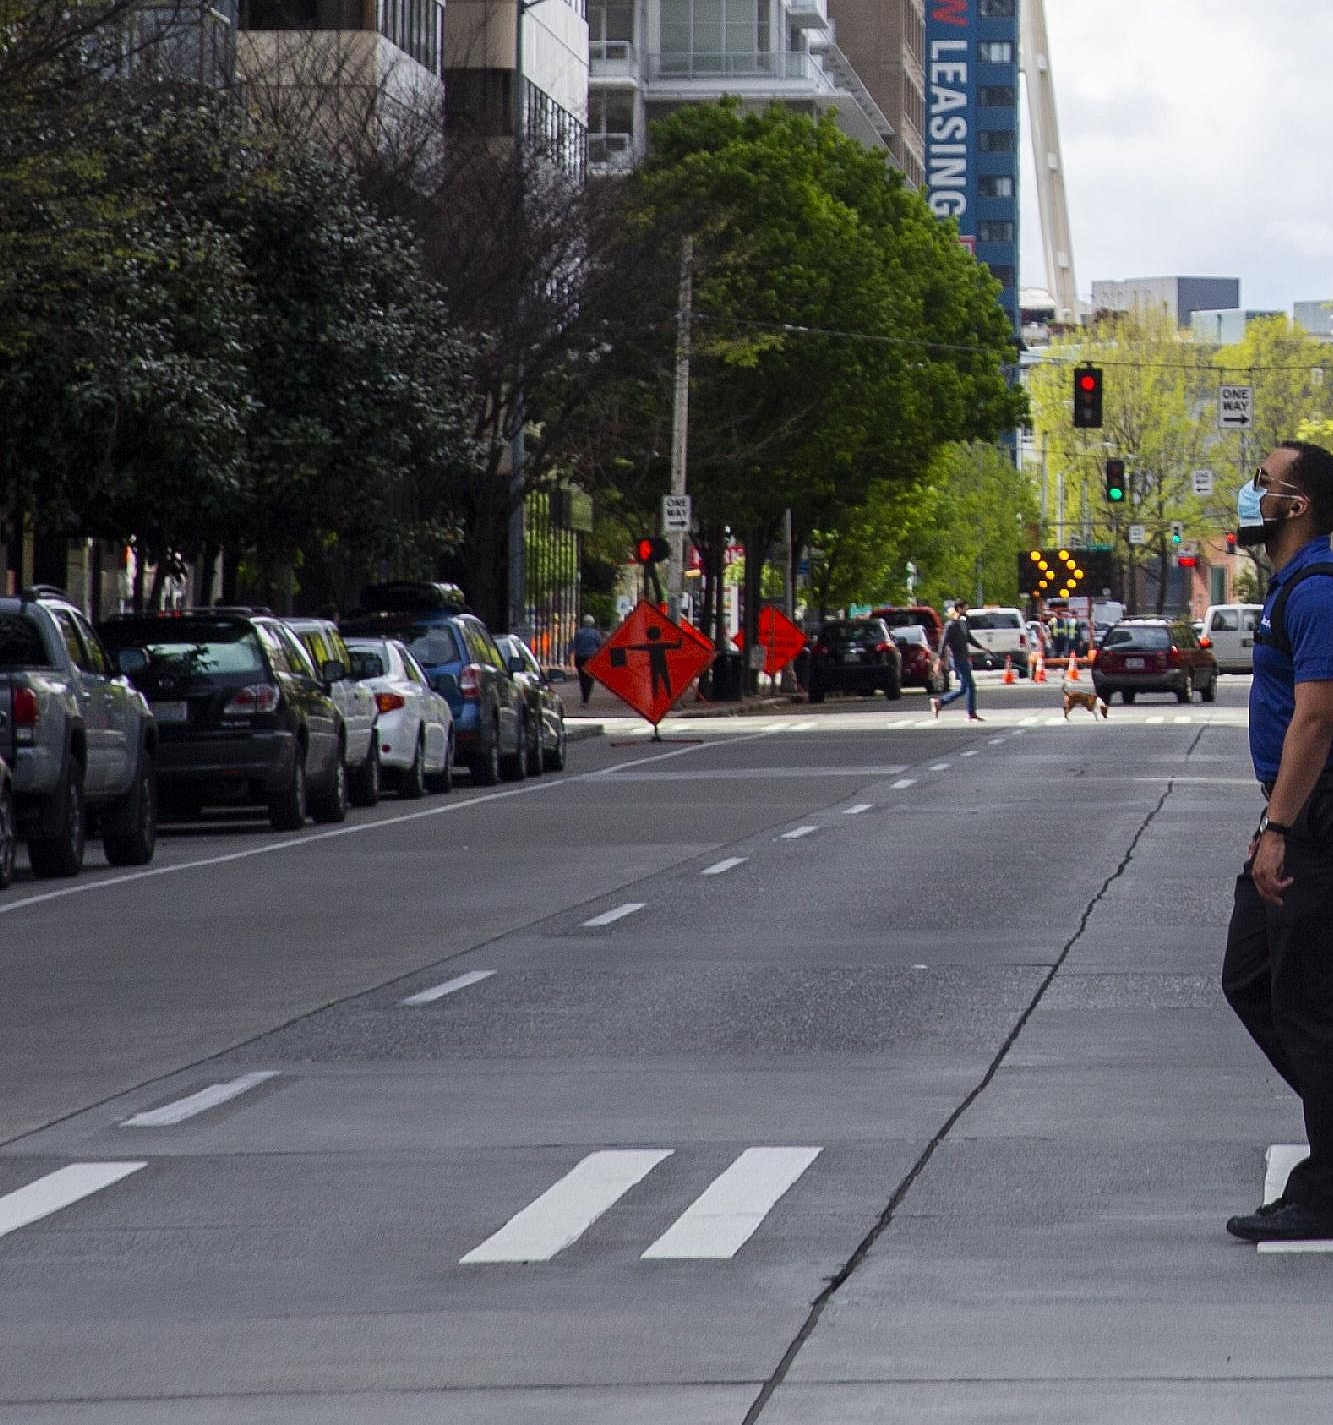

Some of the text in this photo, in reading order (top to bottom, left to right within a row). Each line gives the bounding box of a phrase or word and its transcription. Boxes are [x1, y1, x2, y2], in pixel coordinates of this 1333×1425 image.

[928, 40, 967, 219] LEASING
[1222, 389, 1249, 399] ONE
[1222, 400, 1249, 411] WAY
